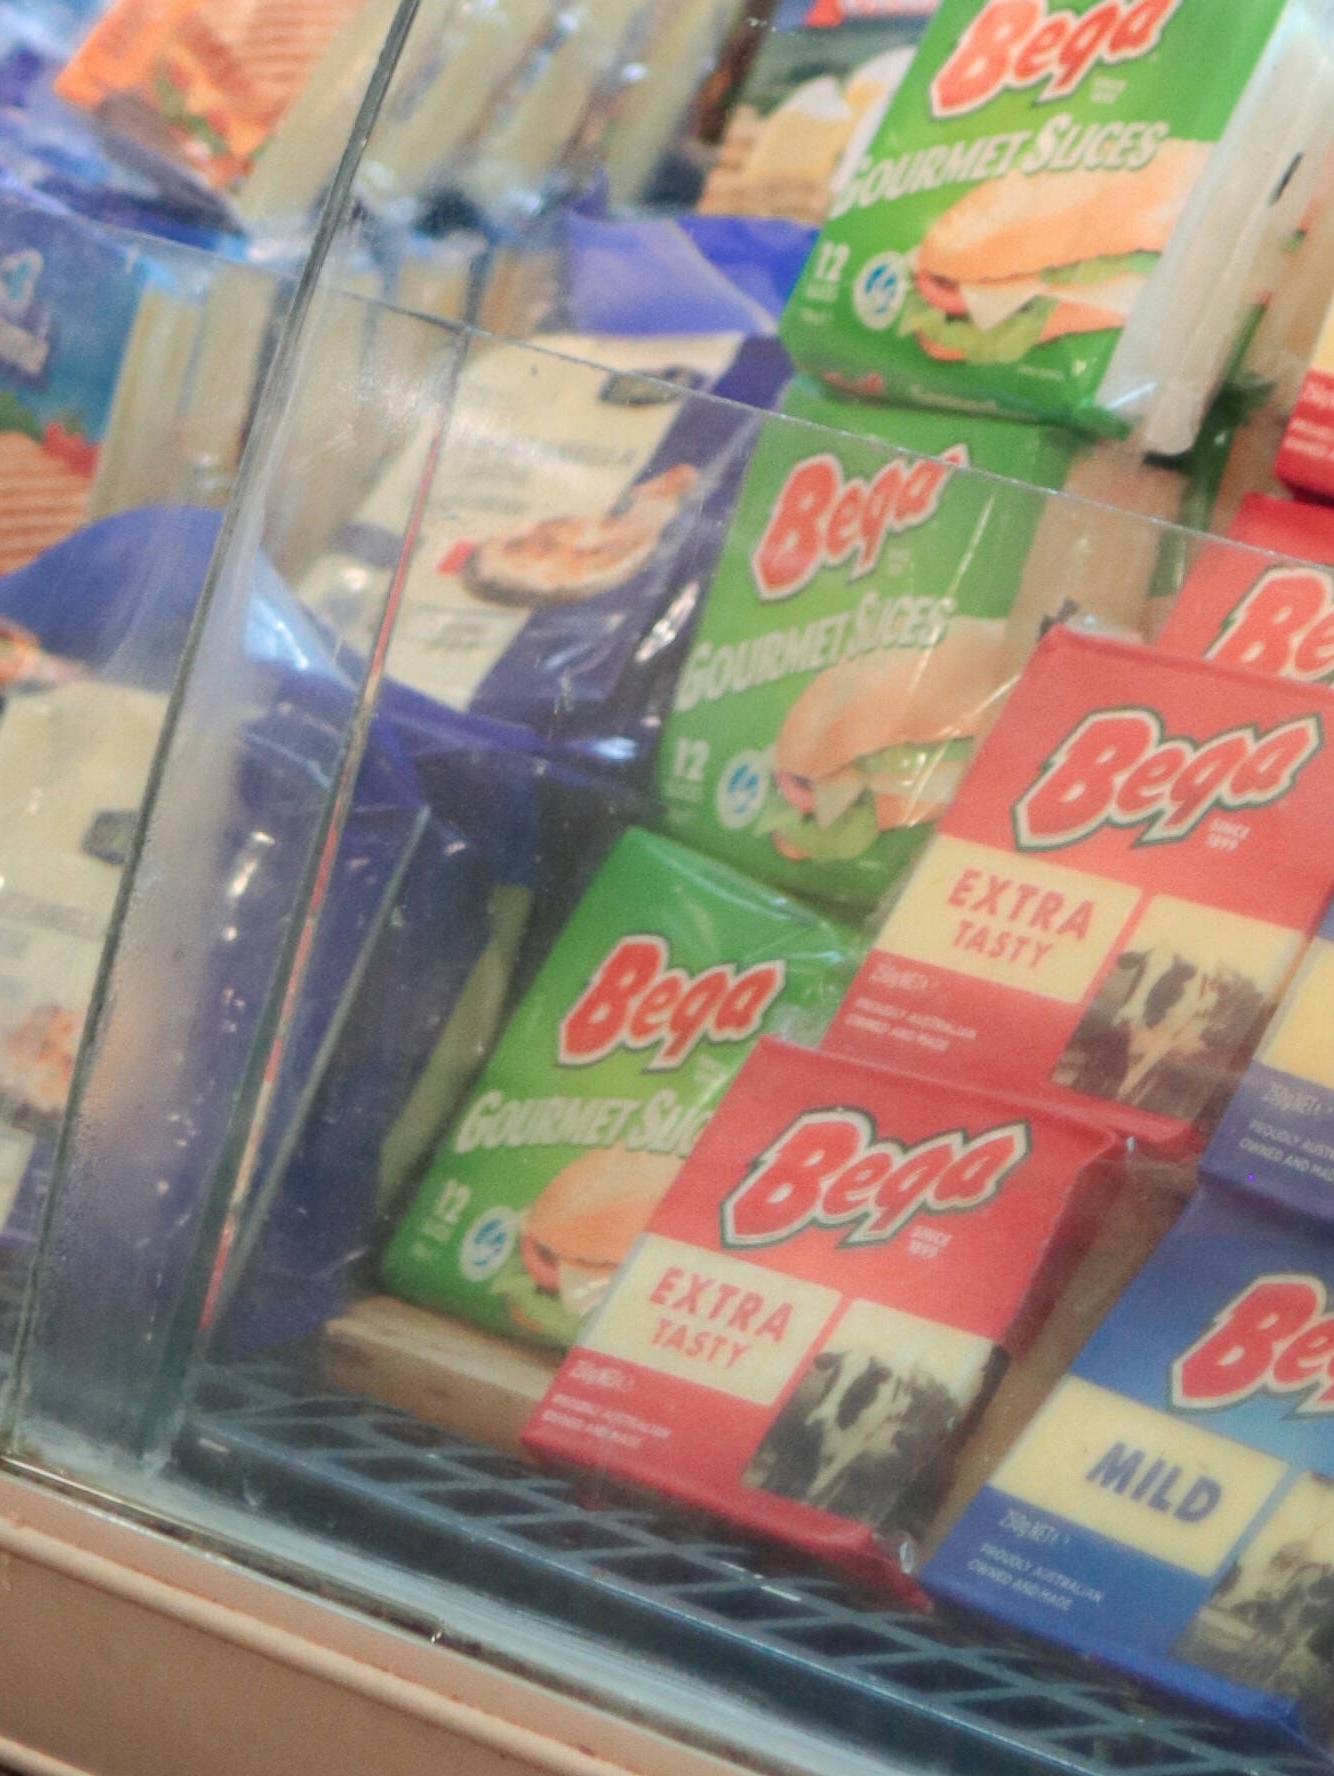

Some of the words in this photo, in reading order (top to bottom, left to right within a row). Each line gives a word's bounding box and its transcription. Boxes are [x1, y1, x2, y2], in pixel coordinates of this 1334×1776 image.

[828, 130, 1031, 220] GOURMET
[1023, 112, 1169, 176] SLICES
[815, 243, 849, 283] 12
[751, 446, 970, 602] Bega
[675, 611, 851, 712] GOURMET
[1012, 705, 1324, 852] Bega
[947, 867, 1094, 941] EXTRA
[952, 919, 1054, 969] TASTY
[557, 934, 787, 1074] Bega
[454, 1089, 640, 1154] GOURMET
[720, 1106, 1033, 1249] Bega
[649, 1266, 794, 1343] EXTRA
[651, 1318, 751, 1369] TASTY
[1083, 1440, 1223, 1523] MILD
